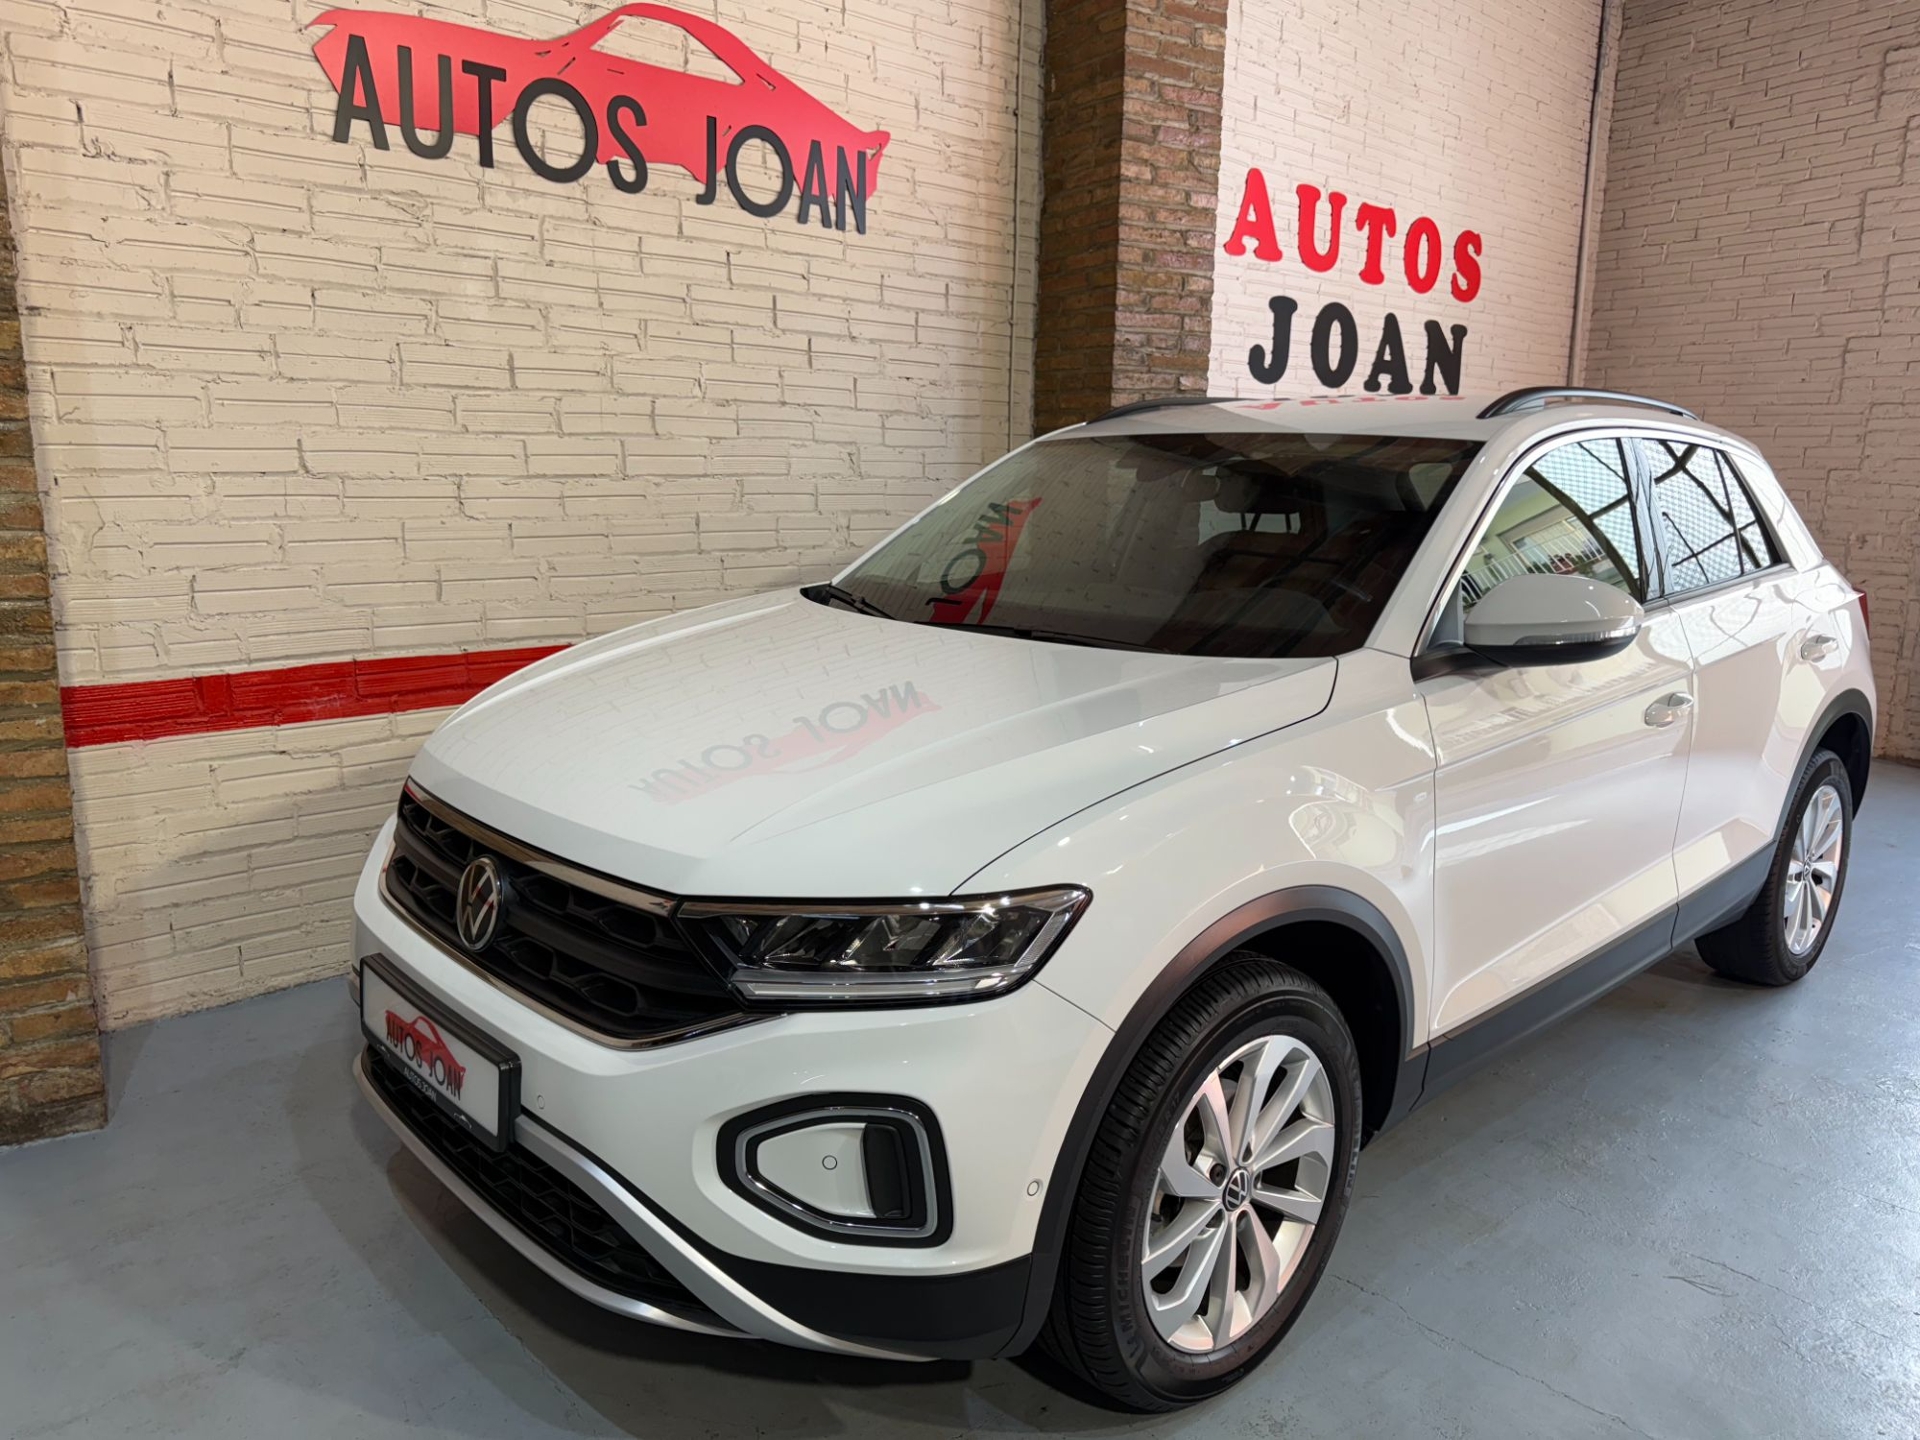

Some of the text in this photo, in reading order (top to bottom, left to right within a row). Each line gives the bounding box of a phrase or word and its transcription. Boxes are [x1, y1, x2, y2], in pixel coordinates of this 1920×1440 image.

[333, 34, 867, 235] AUTOS JOAN
[1223, 167, 1483, 303] AUTOS
[1248, 295, 1468, 396] JOAN
[386, 1014, 462, 1101] AUTOS JOAN
